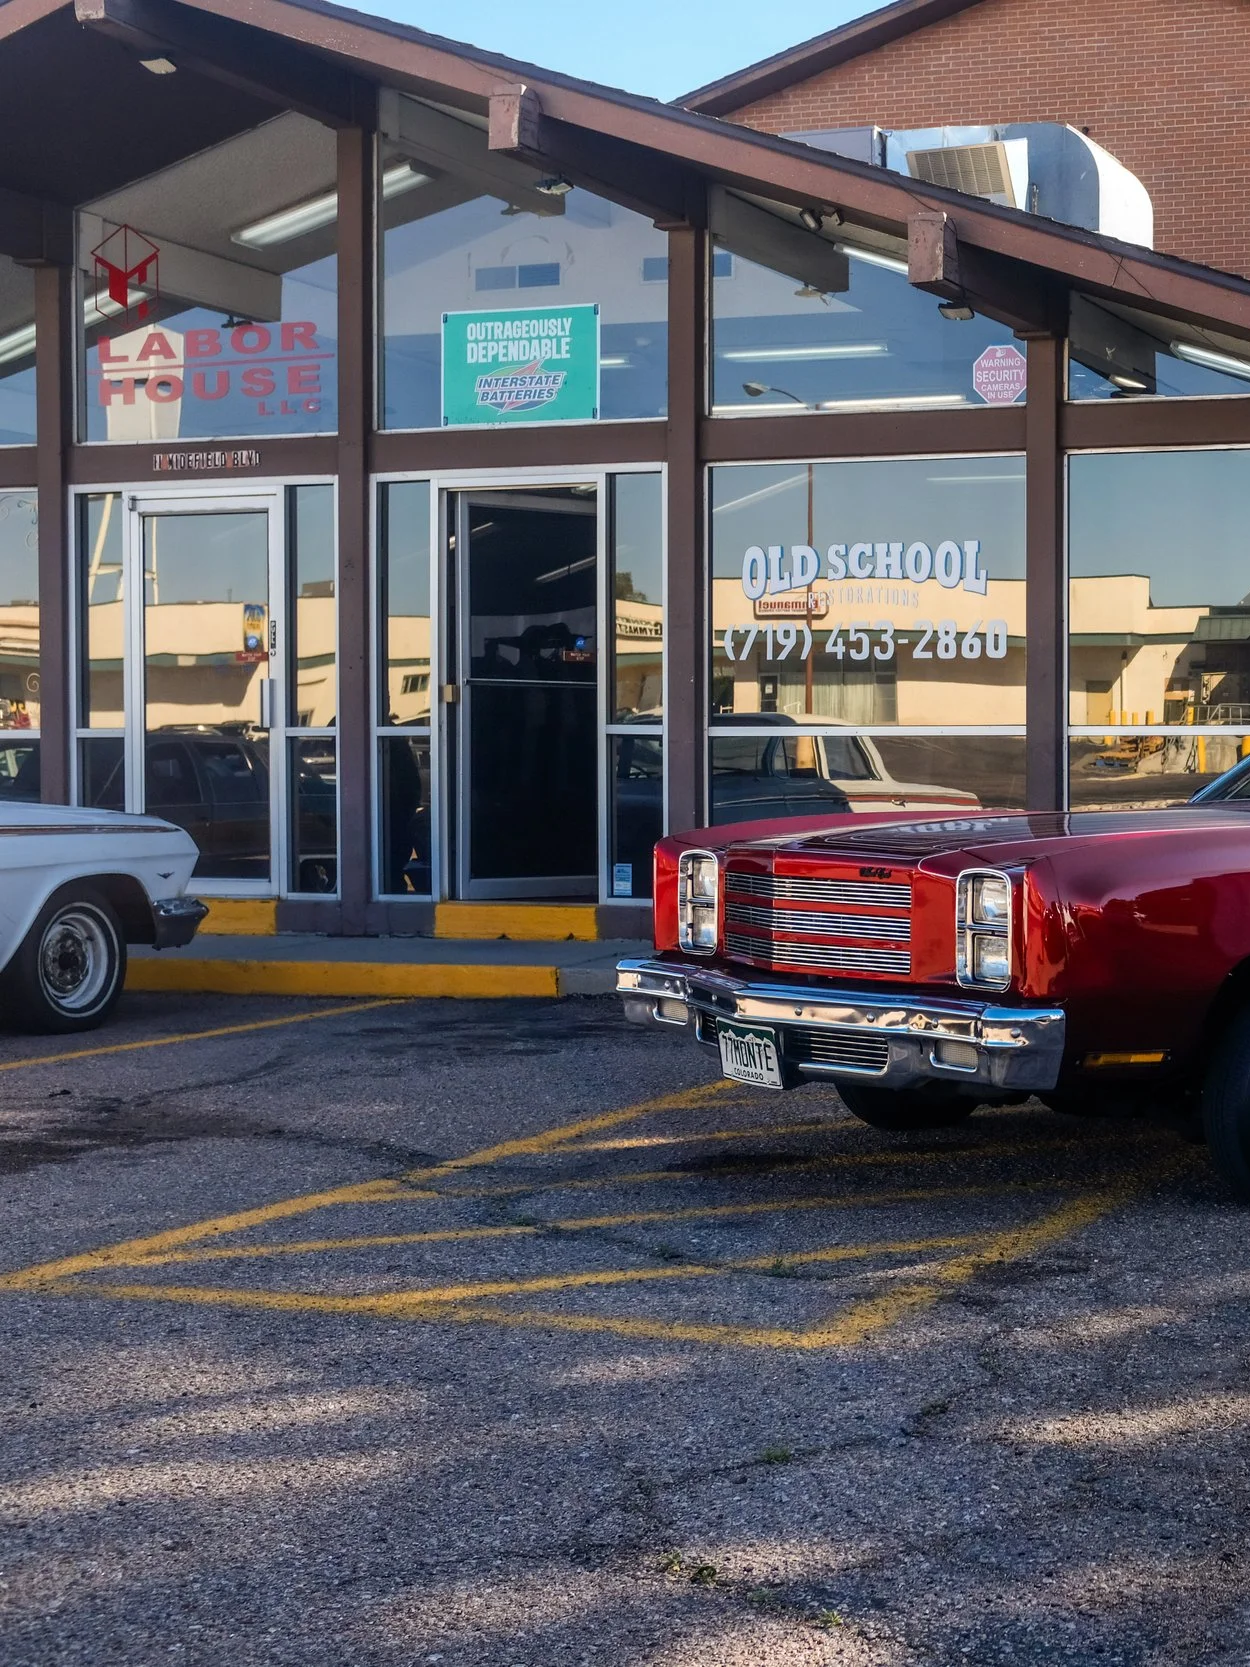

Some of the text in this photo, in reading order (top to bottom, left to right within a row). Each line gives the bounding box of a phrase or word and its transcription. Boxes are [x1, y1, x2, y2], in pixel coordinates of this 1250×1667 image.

[466, 317, 573, 341] OUTRAGEOUSLY
[97, 321, 320, 364] LABOR
[466, 337, 571, 364] DEPENDABLE
[980, 357, 1021, 368] WARNING
[477, 373, 562, 389] INTERSTATE
[976, 369, 1025, 383] SECURITY
[99, 364, 322, 407] HOUSE
[981, 382, 1021, 392] CAMERAS
[987, 390, 1014, 399] IN USE
[480, 388, 555, 402] BATTERIES
[258, 398, 322, 416] LLC
[232, 450, 261, 468] BLVD
[741, 539, 989, 600] OLD SCHOOL
[808, 585, 920, 609] RESTORATIONS
[723, 619, 1008, 661] (719) 453-2860
[721, 1034, 775, 1072] 77MONTE
[734, 1067, 764, 1081] COLORADO
